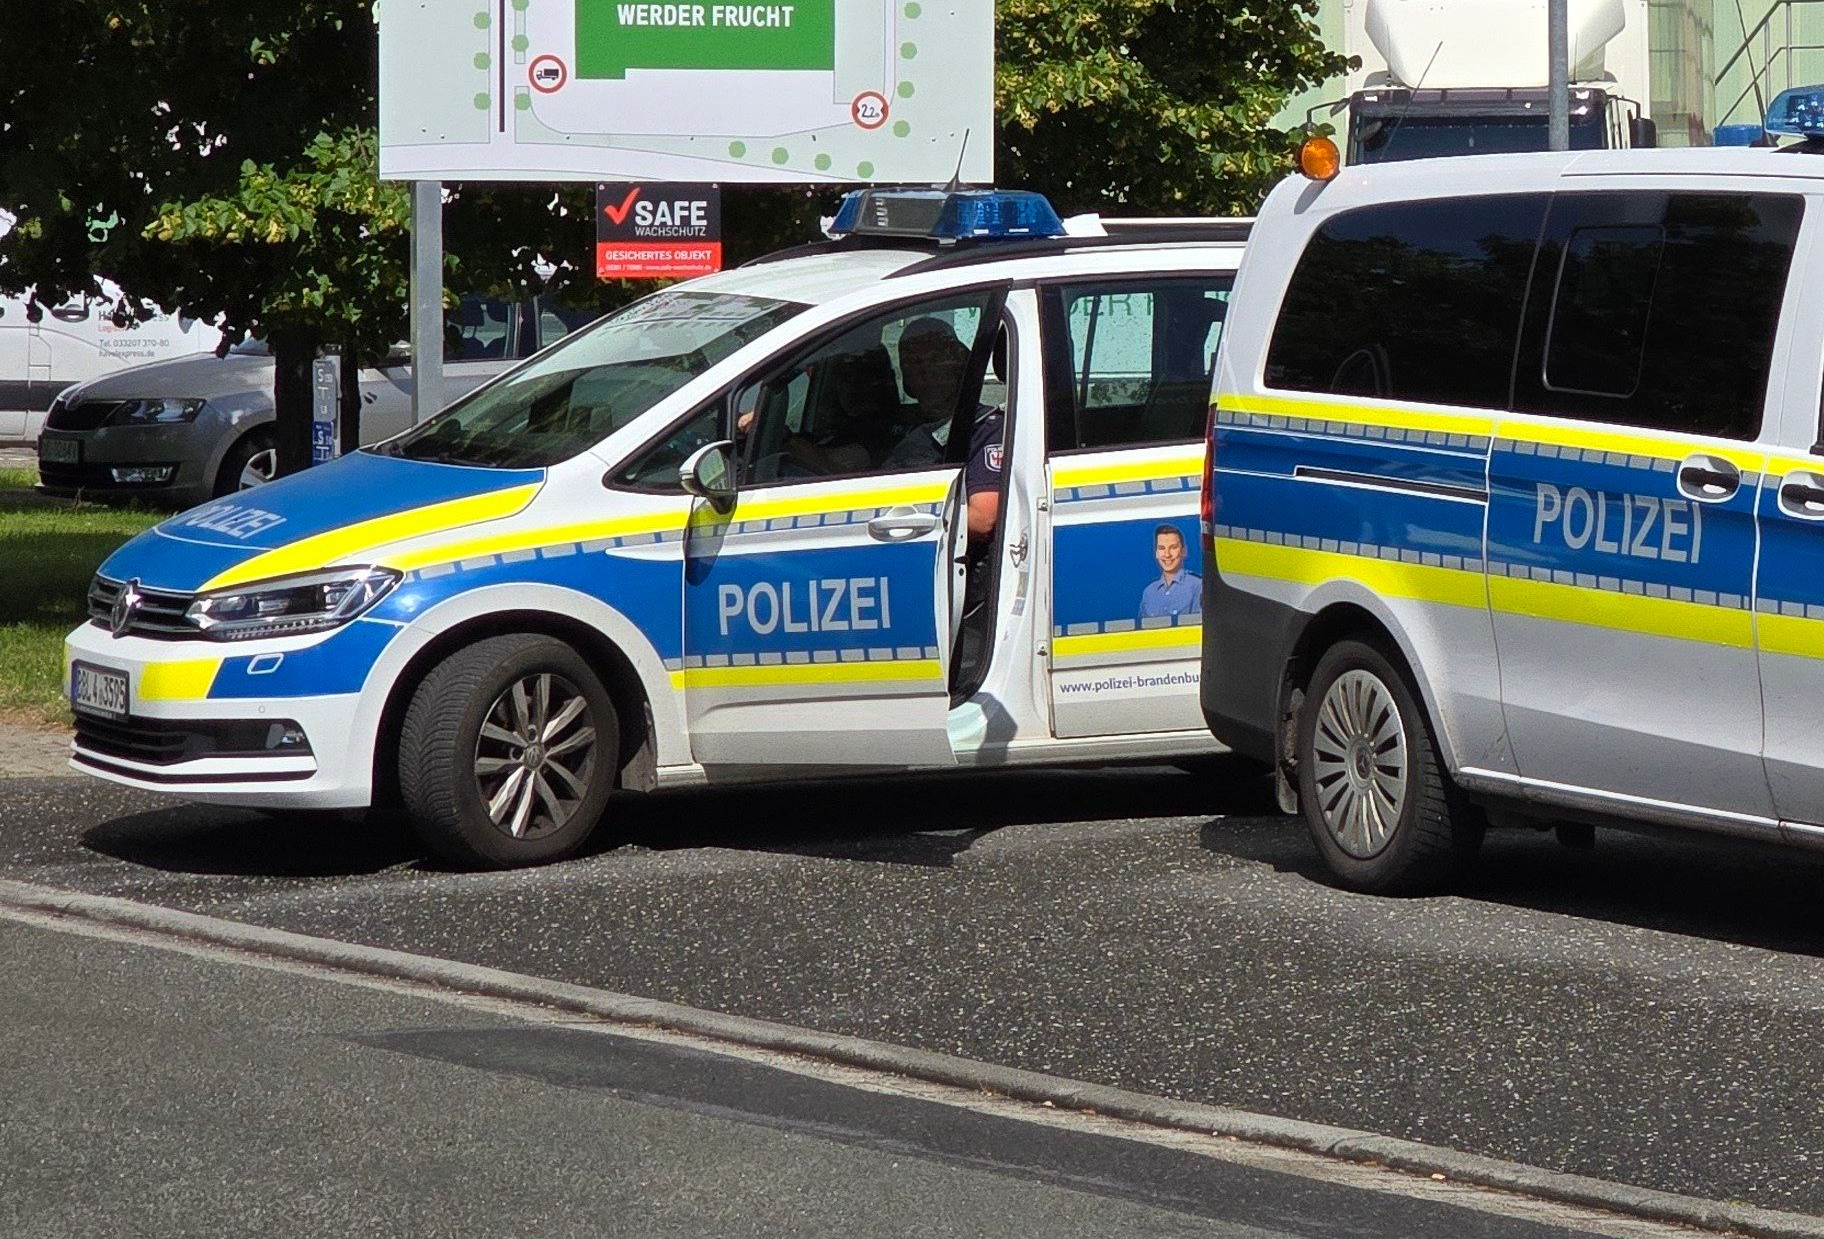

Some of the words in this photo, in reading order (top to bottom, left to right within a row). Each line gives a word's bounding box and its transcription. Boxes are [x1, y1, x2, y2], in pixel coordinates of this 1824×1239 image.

[617, 4, 705, 26] WERDER
[712, 5, 794, 27] FRUCHT
[635, 201, 707, 226] SAFE
[635, 227, 706, 237] WACHSCHUTZ
[605, 250, 672, 261] GESICHERTES
[674, 250, 712, 260] OBJEKT
[1533, 482, 1702, 564] POLIZEI
[718, 576, 891, 635] POLIZEI
